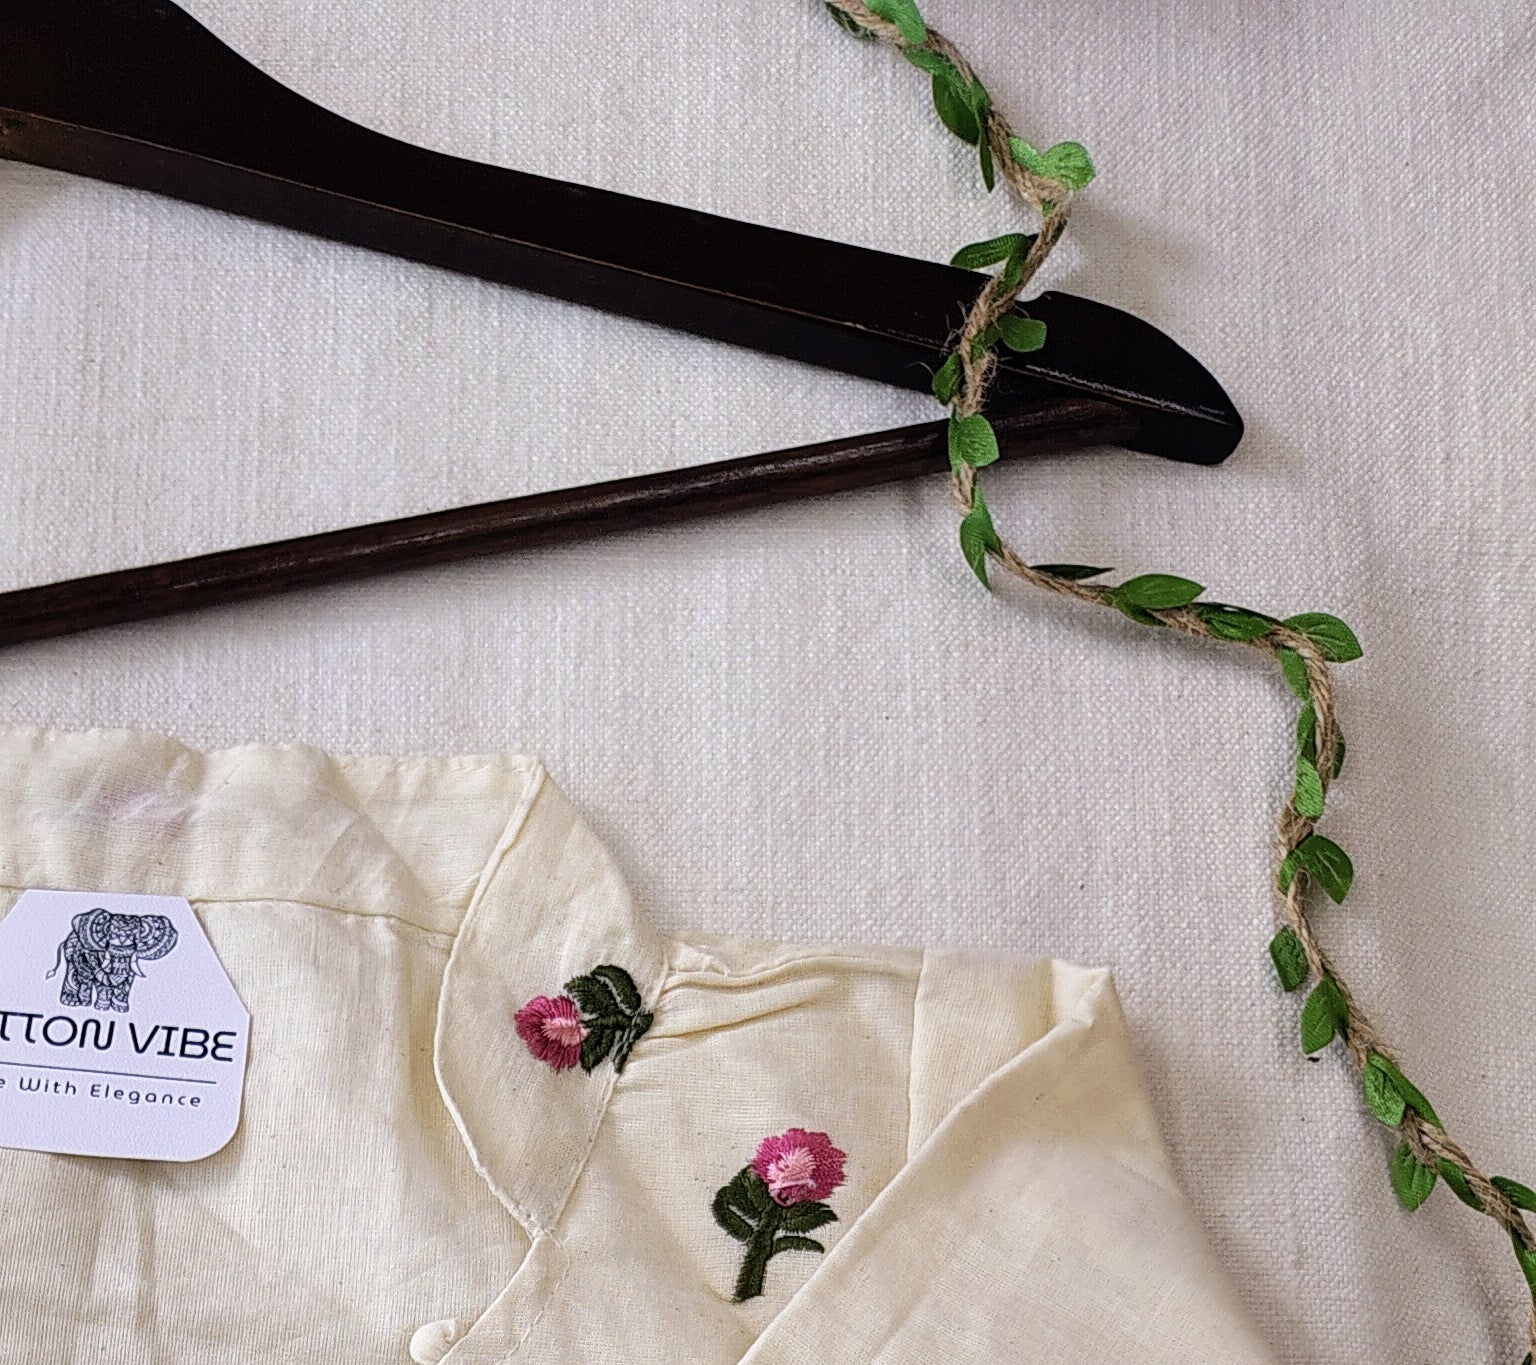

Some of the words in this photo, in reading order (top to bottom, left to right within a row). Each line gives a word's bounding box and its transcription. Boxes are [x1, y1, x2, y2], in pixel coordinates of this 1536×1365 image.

[129, 1022, 237, 1063] VIBE
[19, 1075, 77, 1096] With
[90, 1083, 202, 1108] Elegance
